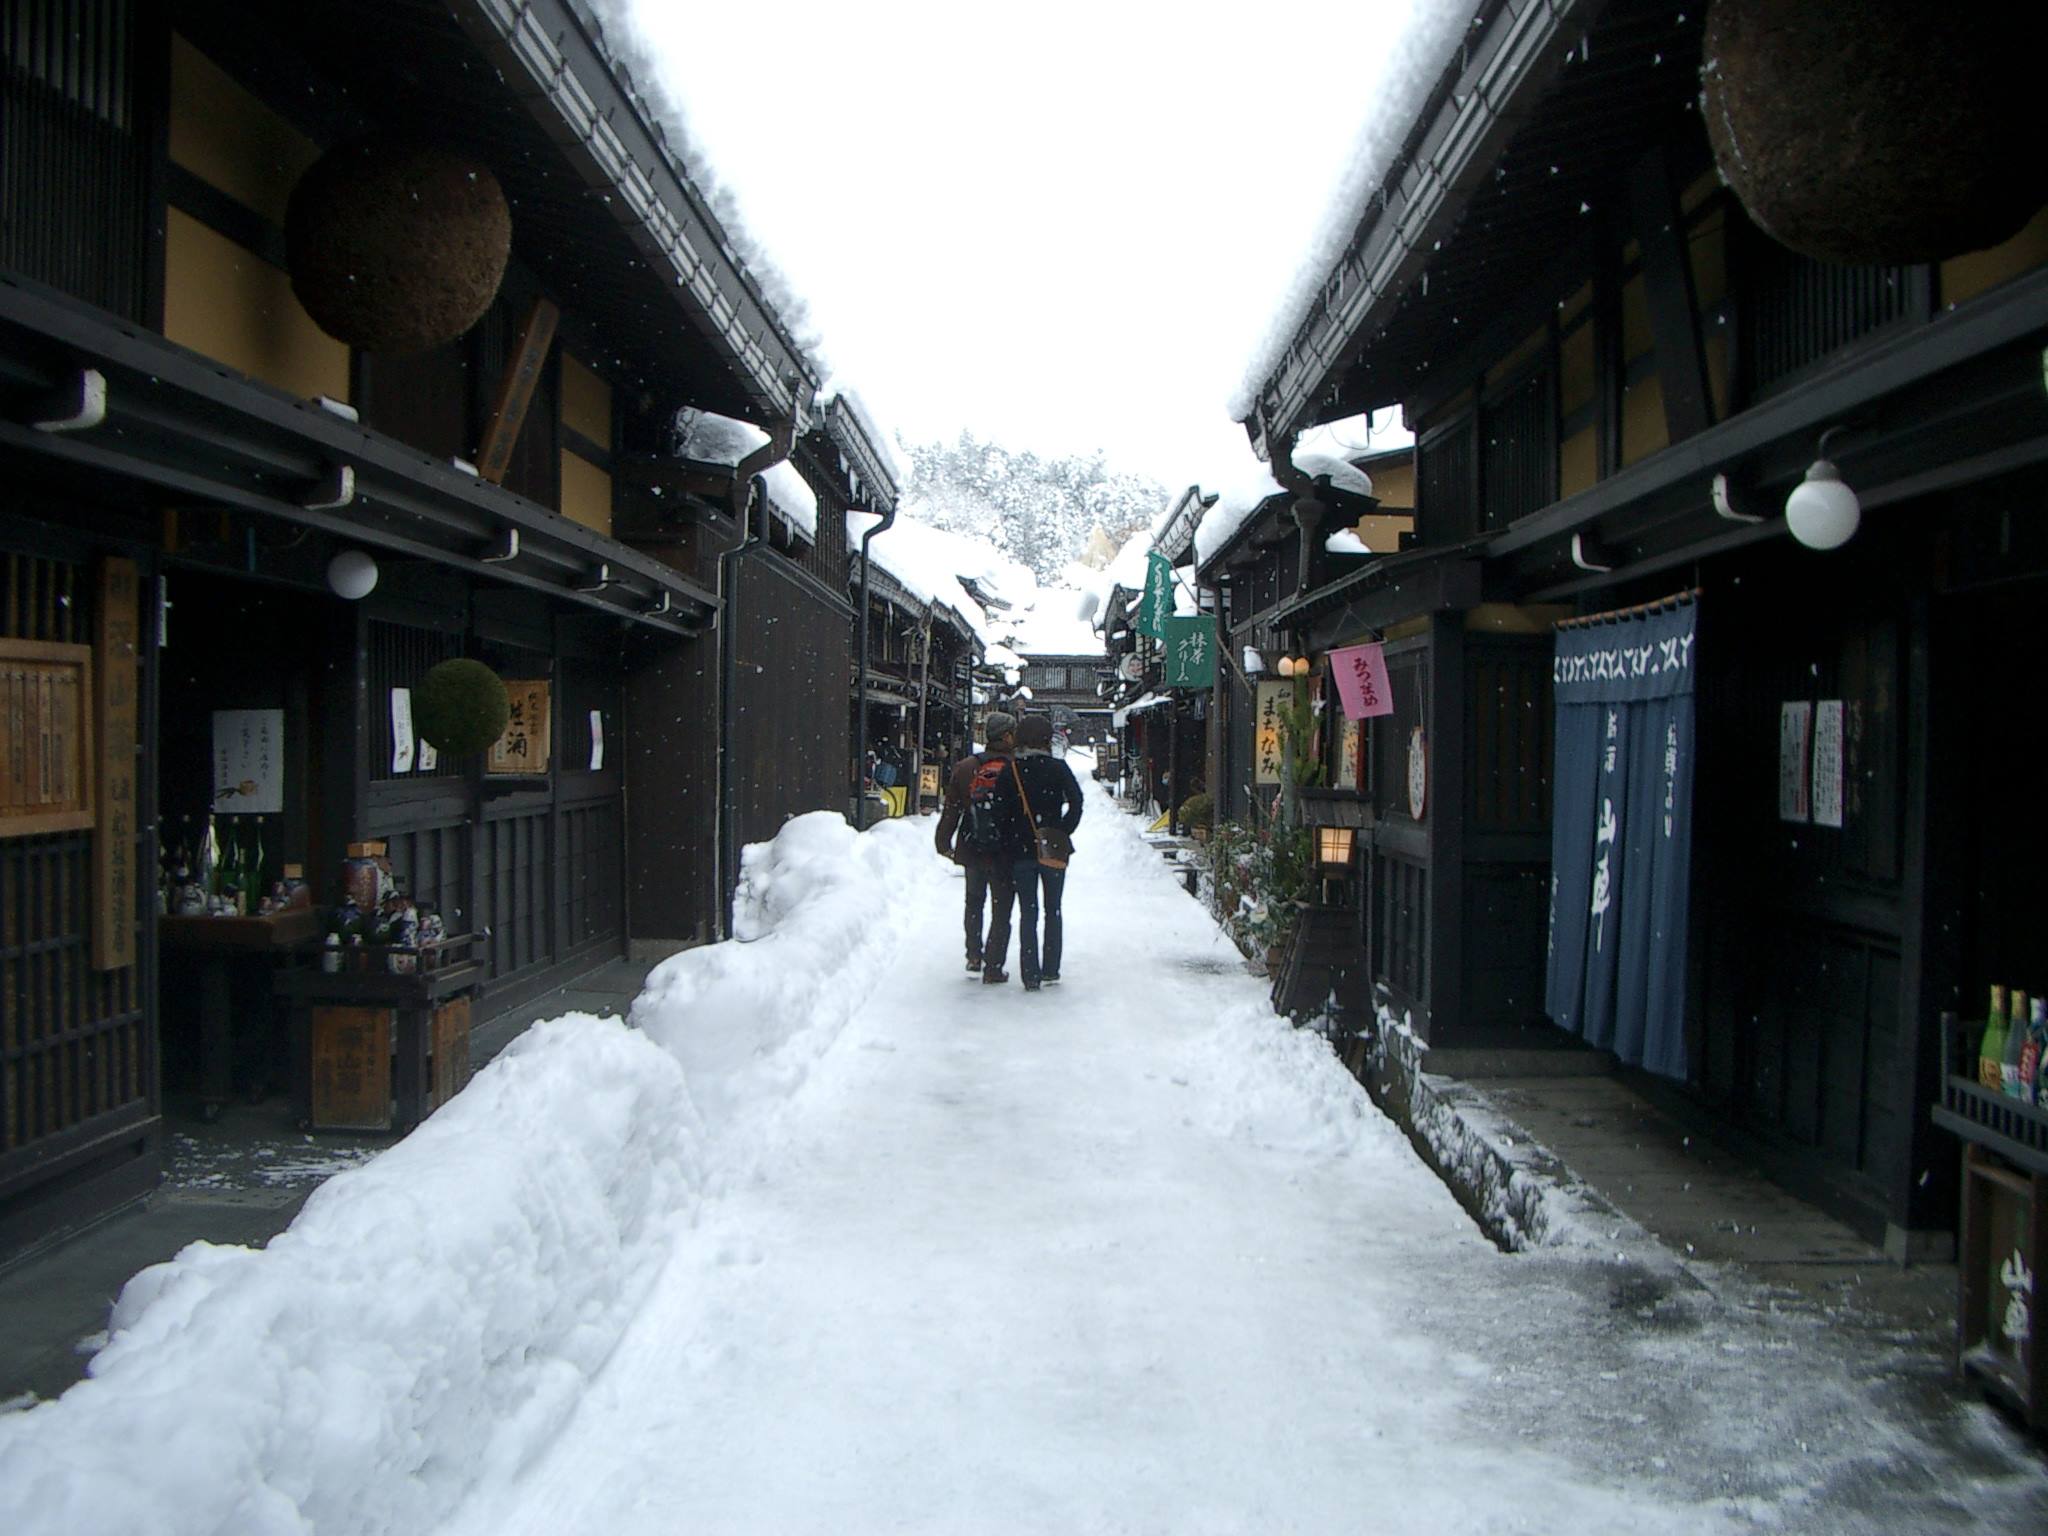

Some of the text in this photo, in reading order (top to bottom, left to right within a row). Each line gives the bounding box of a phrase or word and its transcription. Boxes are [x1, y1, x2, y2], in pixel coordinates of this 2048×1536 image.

[1177, 639, 1191, 682] クリーム
[1189, 631, 1208, 665] 抹茶
[1354, 657, 1378, 707] みつまめ
[1260, 696, 1276, 775] まちなみ
